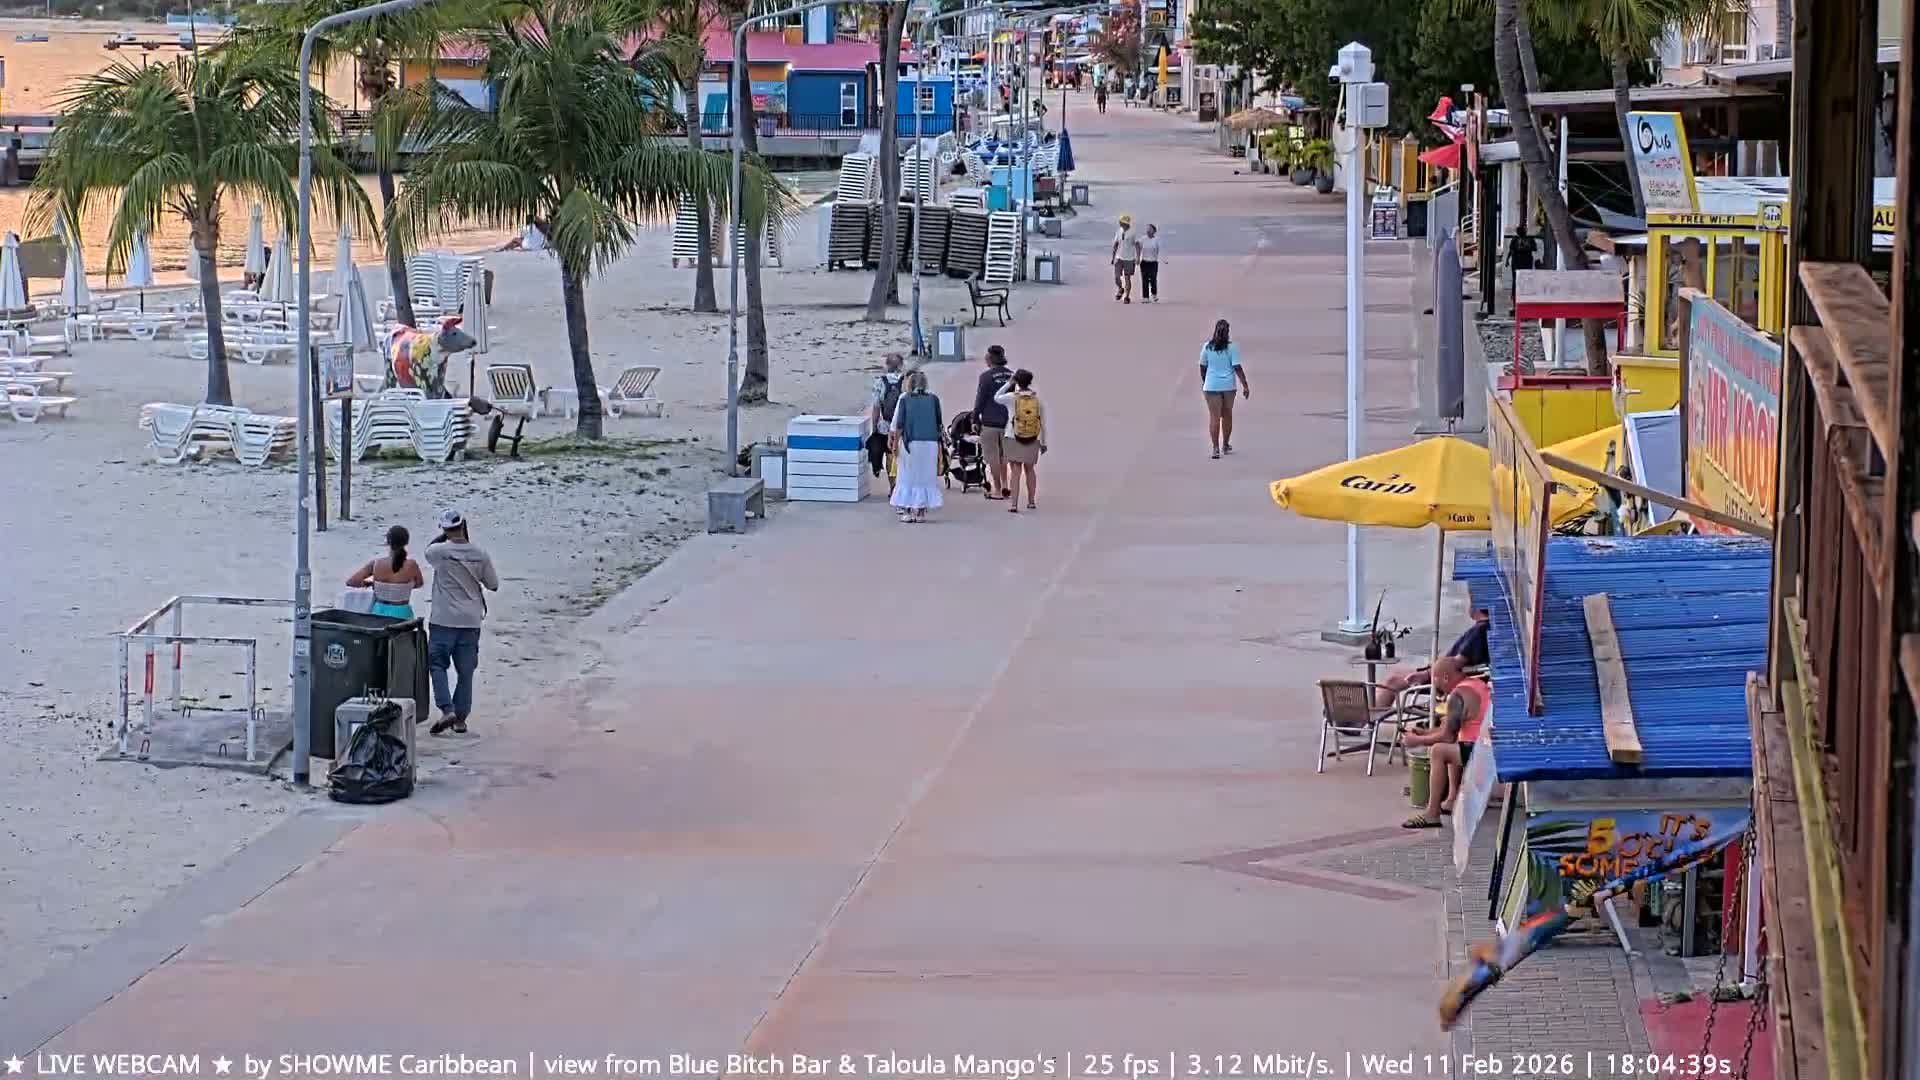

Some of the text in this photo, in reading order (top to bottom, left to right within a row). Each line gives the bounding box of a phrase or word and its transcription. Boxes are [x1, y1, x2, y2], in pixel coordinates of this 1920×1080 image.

[1680, 215, 1735, 224] FREE WI-FI
[1705, 362, 1729, 483] MR
[1340, 473, 1416, 494] Carib
[1452, 512, 1476, 523] Carib
[1586, 817, 1618, 857] 5
